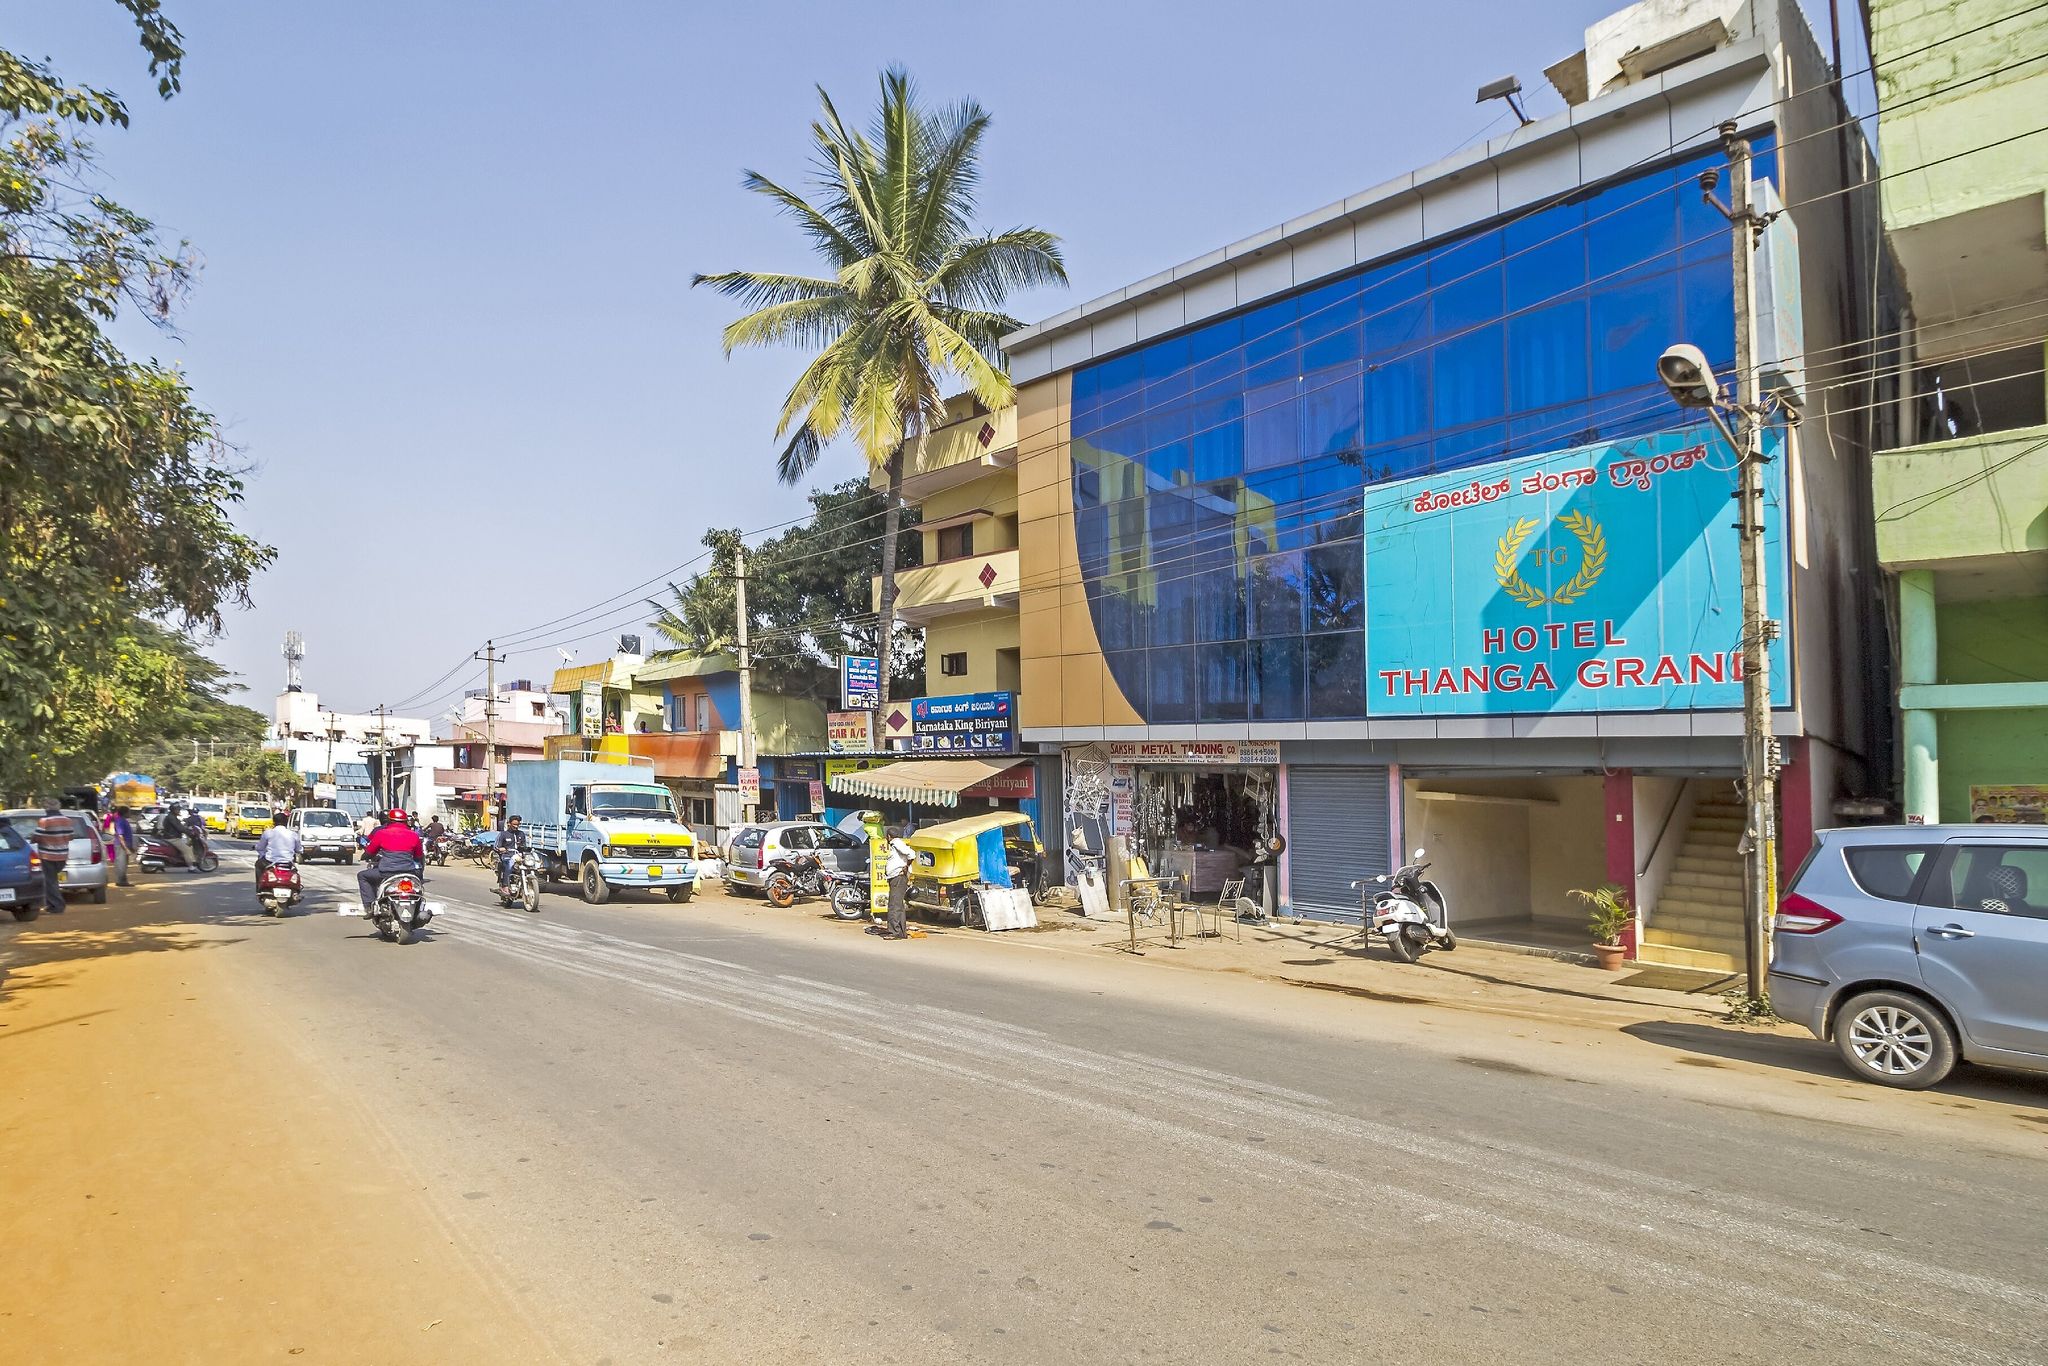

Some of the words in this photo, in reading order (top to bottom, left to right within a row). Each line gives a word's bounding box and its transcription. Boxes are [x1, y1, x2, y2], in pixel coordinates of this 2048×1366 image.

[1413, 478, 1511, 514] ಹೋಟೆಲ್
[1522, 465, 1597, 495] ತಂಗಾ
[1528, 546, 1567, 567] TG
[1482, 618, 1627, 654] HOTEL
[1379, 662, 1557, 696] THANGA
[829, 728, 847, 739] CAR
[850, 727, 866, 739] A/C
[915, 720, 953, 732] Karnataka
[954, 719, 973, 732] King
[975, 717, 1008, 732] Biriyani
[1110, 743, 1136, 754] SAKSHI
[1141, 744, 1176, 754] METAL
[1181, 744, 1224, 755] TRADING
[993, 776, 1029, 791] Biriyani
